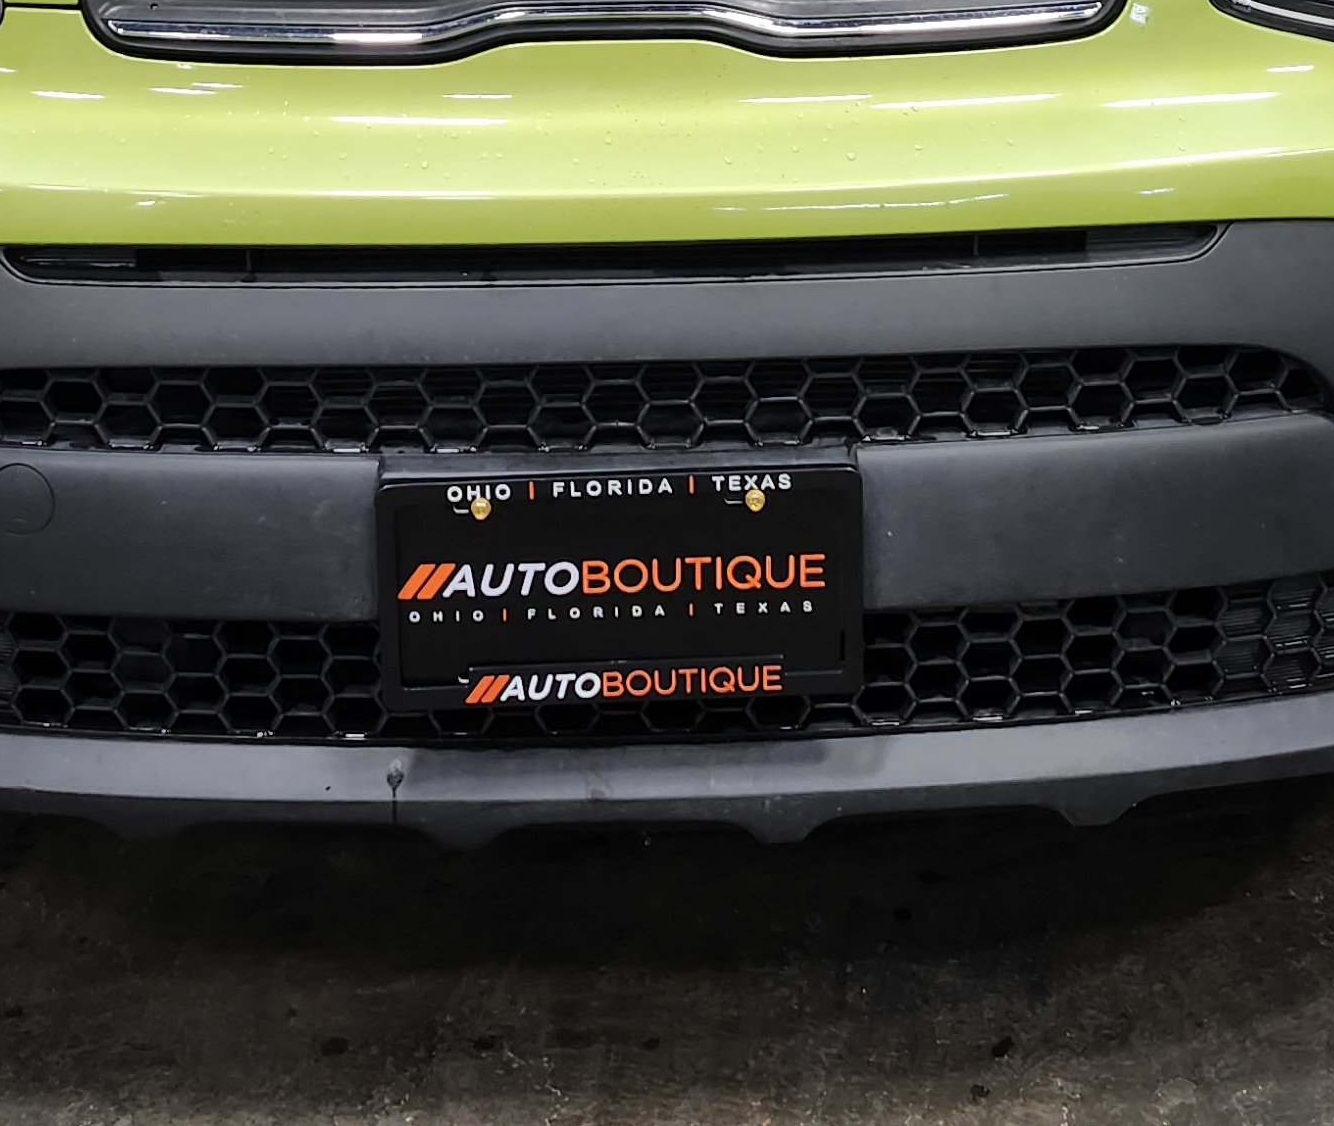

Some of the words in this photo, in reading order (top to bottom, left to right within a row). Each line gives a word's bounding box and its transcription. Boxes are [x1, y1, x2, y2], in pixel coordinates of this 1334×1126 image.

[446, 483, 511, 503] OHIO
[552, 477, 673, 498] FLORIDA
[711, 473, 792, 492] TEXAS
[442, 553, 826, 599] AUTOBOUTIQUE
[408, 610, 484, 623] OHIO
[527, 604, 665, 620] FLORIDA
[714, 600, 813, 614] TEXAS
[499, 665, 783, 703] AUTOBOUTIQUE
